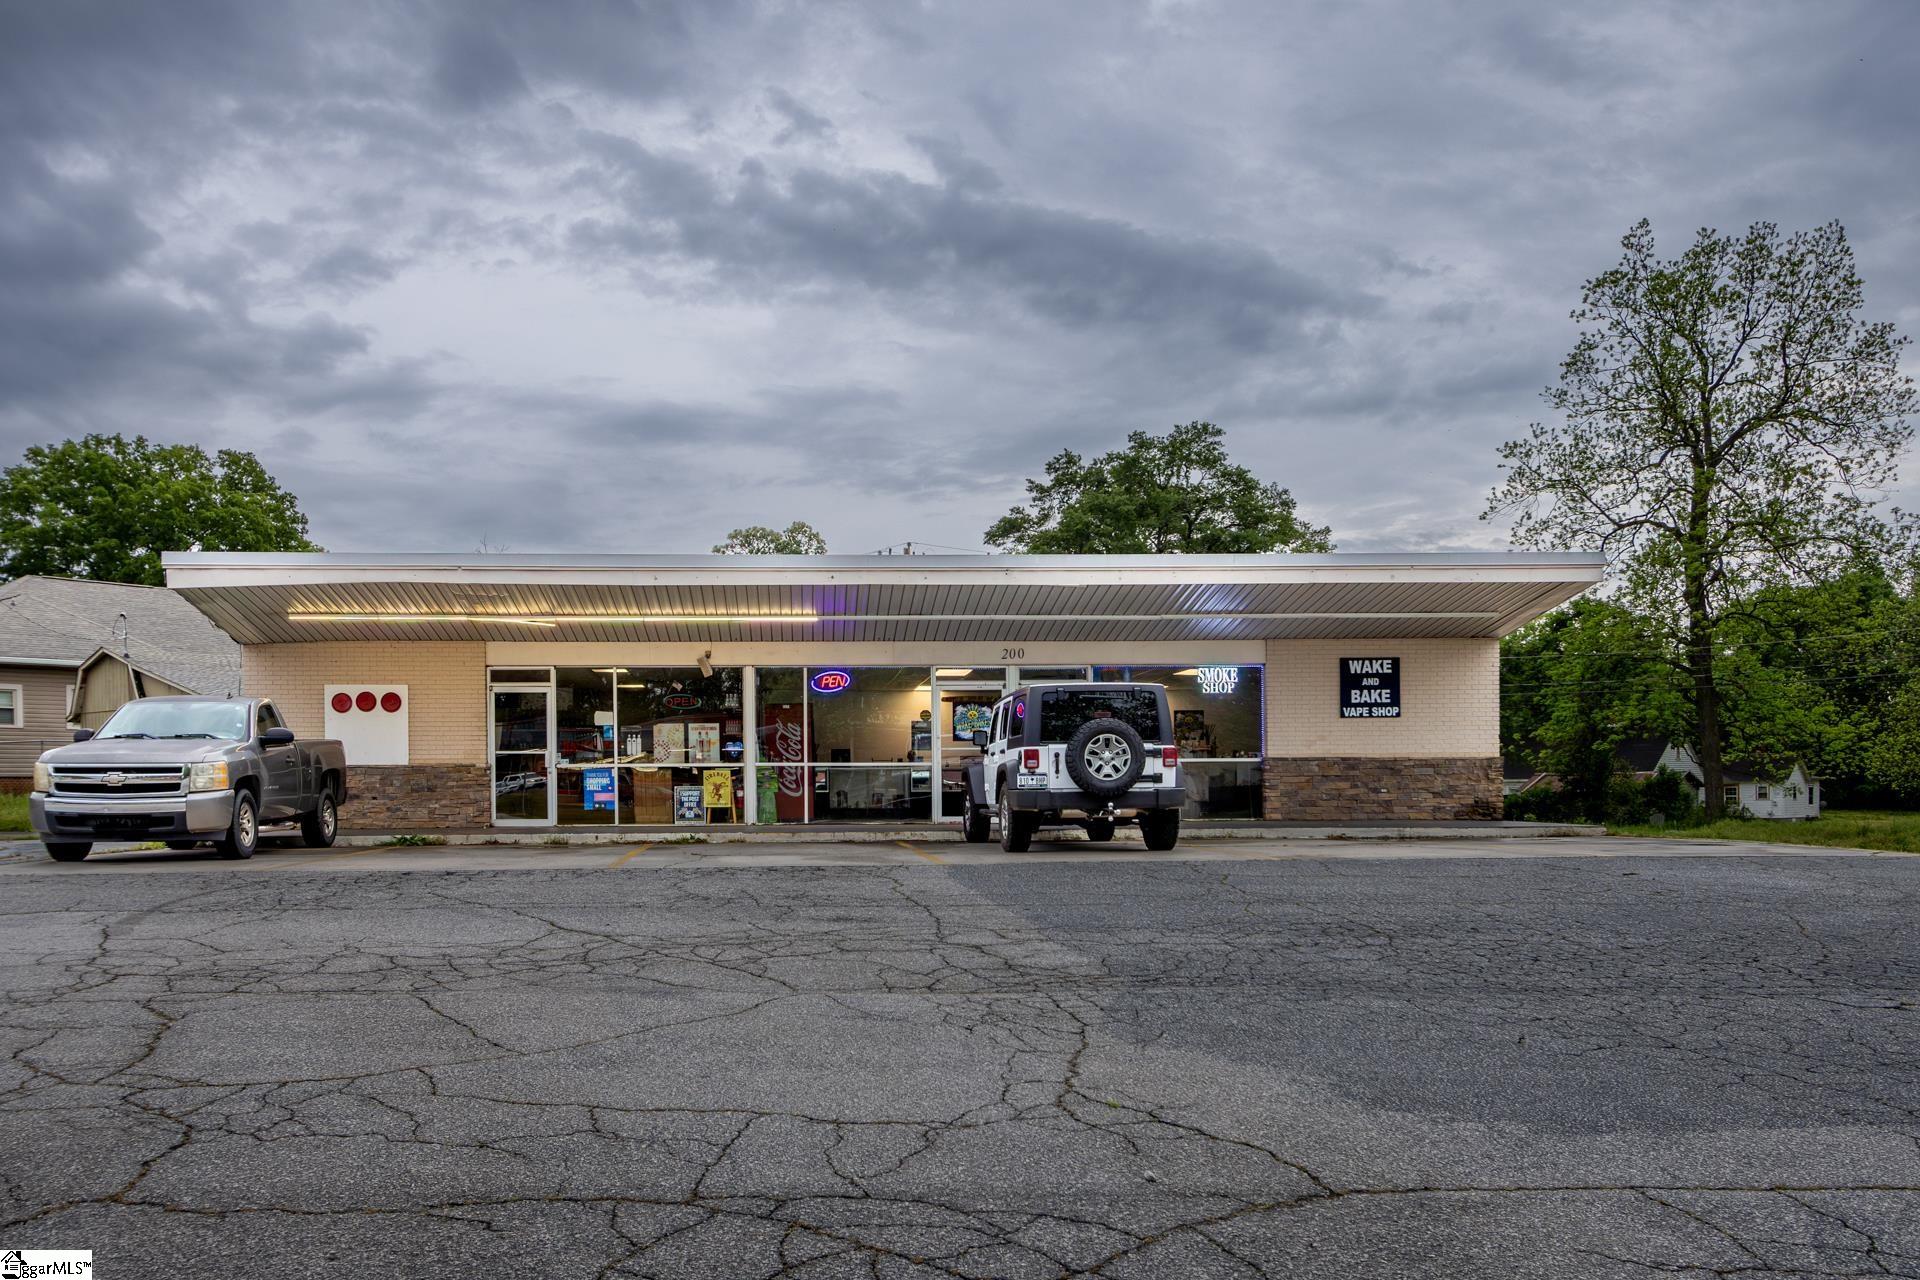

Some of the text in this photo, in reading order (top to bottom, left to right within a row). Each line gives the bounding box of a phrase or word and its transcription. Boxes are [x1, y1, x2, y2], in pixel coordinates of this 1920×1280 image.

[1001, 648, 1025, 660] 200
[1348, 659, 1392, 674] WAKE
[1197, 667, 1239, 683] SMOKE
[1202, 681, 1236, 694] SHOP
[1362, 678, 1380, 686] AND
[666, 697, 697, 706] OPEN
[1351, 689, 1391, 703] BAKE
[1343, 706, 1400, 717] VAPE SHOP
